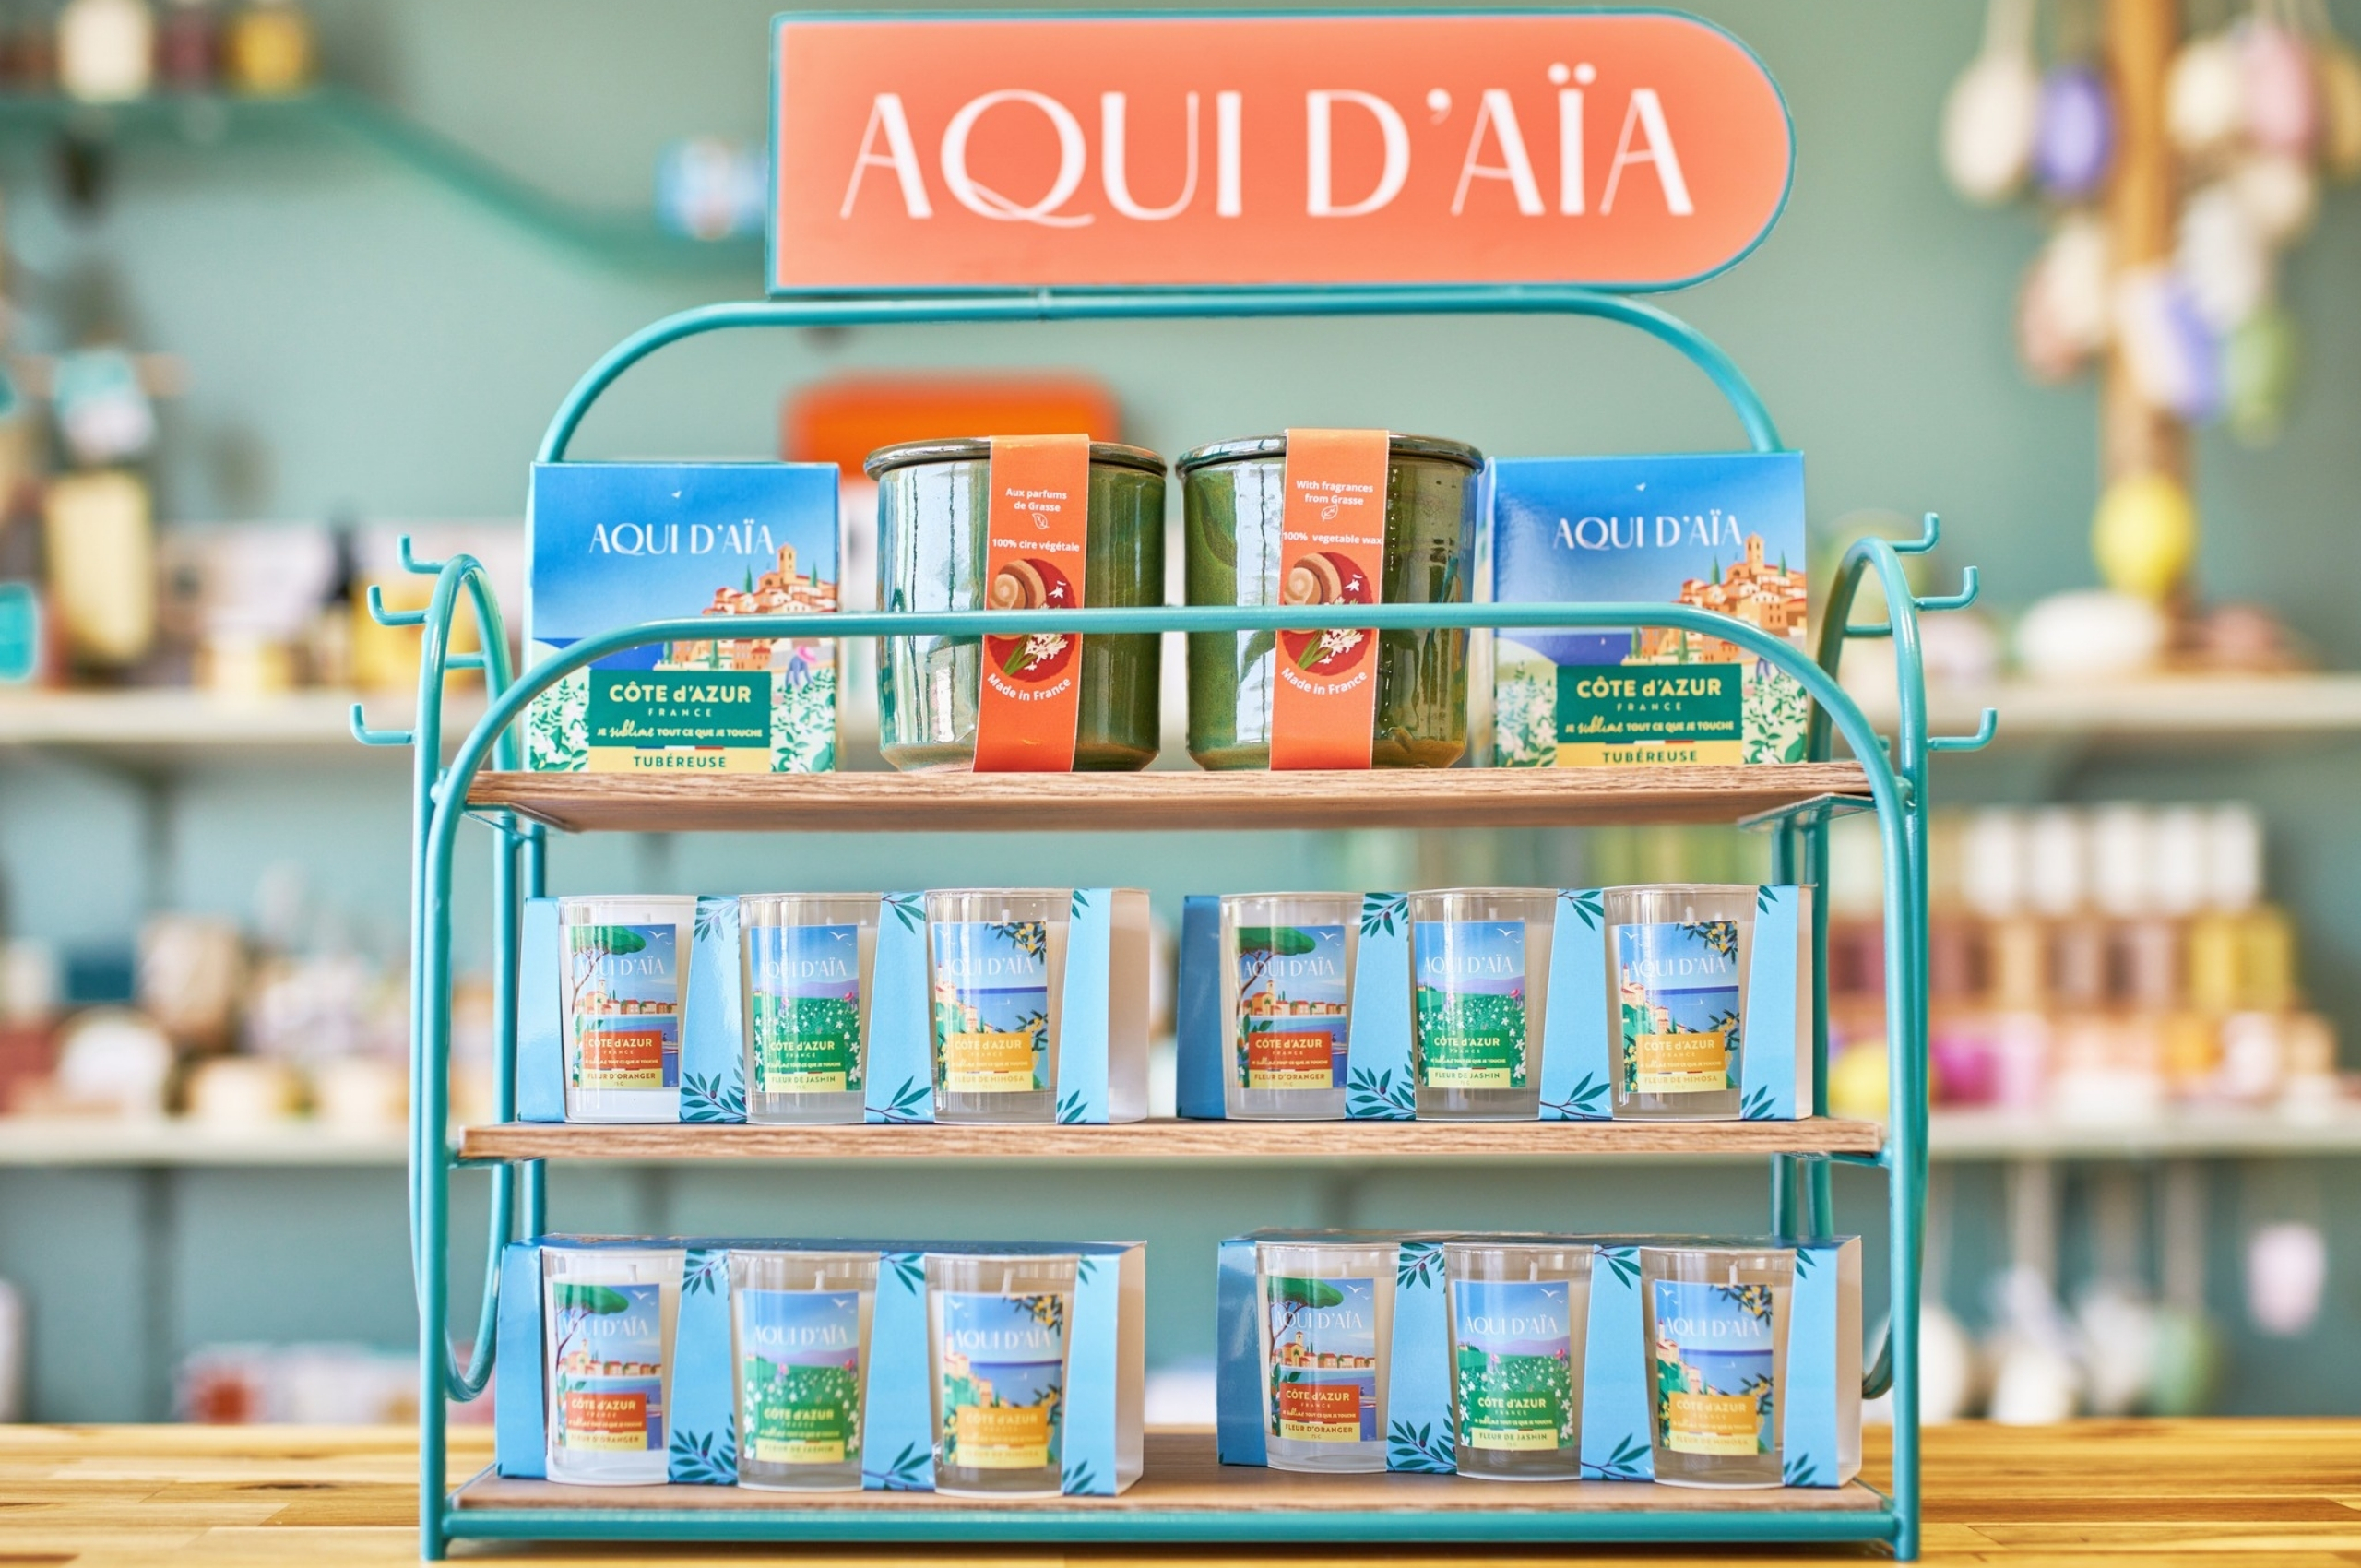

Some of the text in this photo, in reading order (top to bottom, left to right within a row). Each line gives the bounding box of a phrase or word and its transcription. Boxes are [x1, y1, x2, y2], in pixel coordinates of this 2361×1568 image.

[839, 62, 1694, 227] AQUI D'AÏA
[1006, 487, 1067, 500] Aux parfums
[1296, 481, 1373, 493] With fragrances
[1014, 501, 1061, 512] de Grasse
[1304, 493, 1364, 505] from Grasse
[589, 518, 775, 556] AQUI D'AÏA
[1283, 531, 1308, 541] 100%
[1312, 534, 1359, 544] vegetable
[1552, 509, 1742, 551] AQUI D'AÏA
[992, 539, 1080, 552] 100% cire végétale
[987, 672, 1071, 701] Made in France
[1281, 667, 1367, 695] Made in France
[1577, 675, 1722, 698] CÔTE d'AZUR
[609, 681, 752, 703] CÔTE d'AZUR
[648, 708, 712, 718] FRANCE
[1617, 702, 1681, 712] FRANCE
[598, 719, 763, 739] JE sublime TOUT CE QUE JE TOUCHE
[1577, 714, 1623, 734] sublime
[1626, 722, 1651, 731] TOUT
[1652, 722, 1664, 731] CE
[1665, 721, 1684, 733] QUE
[1697, 720, 1734, 731] TOUCHE
[634, 753, 727, 767] TUBÉREUSE
[1602, 747, 1697, 763] TUBÉREUSE
[620, 956, 665, 976] D'AÏA
[801, 956, 848, 978] D'AÏA
[988, 955, 1034, 976] D'AÏA
[1245, 956, 1335, 978] AQUI D'AÏA
[1424, 954, 1513, 975] AQUI D'AÏA
[1631, 954, 1726, 978] AQUI D'AÏA
[614, 1038, 653, 1048] d'AZUR
[796, 1041, 836, 1051] d'AZUR
[982, 1039, 1022, 1050] d'AZUR
[1255, 1038, 1323, 1049] CÔTE d'AZUR
[1433, 1035, 1500, 1046] CÔTE d'AZUR
[1644, 1039, 1715, 1051] CÔTE d'AZUR
[603, 1315, 648, 1336] D'AÏA
[1277, 1310, 1363, 1328] AQUI D'AÏA
[1466, 1314, 1558, 1336] AQUI D'AÏA
[1667, 1316, 1761, 1337] AQUI D'AÏA
[755, 1324, 848, 1346] AQUI D'AÏA
[955, 1329, 999, 1350] AQUI
[1286, 1388, 1350, 1401] CÔTE d'AZUR
[1477, 1396, 1547, 1408] CÔTE d'AZUR
[571, 1397, 636, 1411] CÔTE d'AZUR
[1676, 1399, 1704, 1411] CÔTE
[764, 1408, 835, 1420] CÔTE d'AZUR
[1285, 1423, 1353, 1433] FLEUR D'ORANGER
